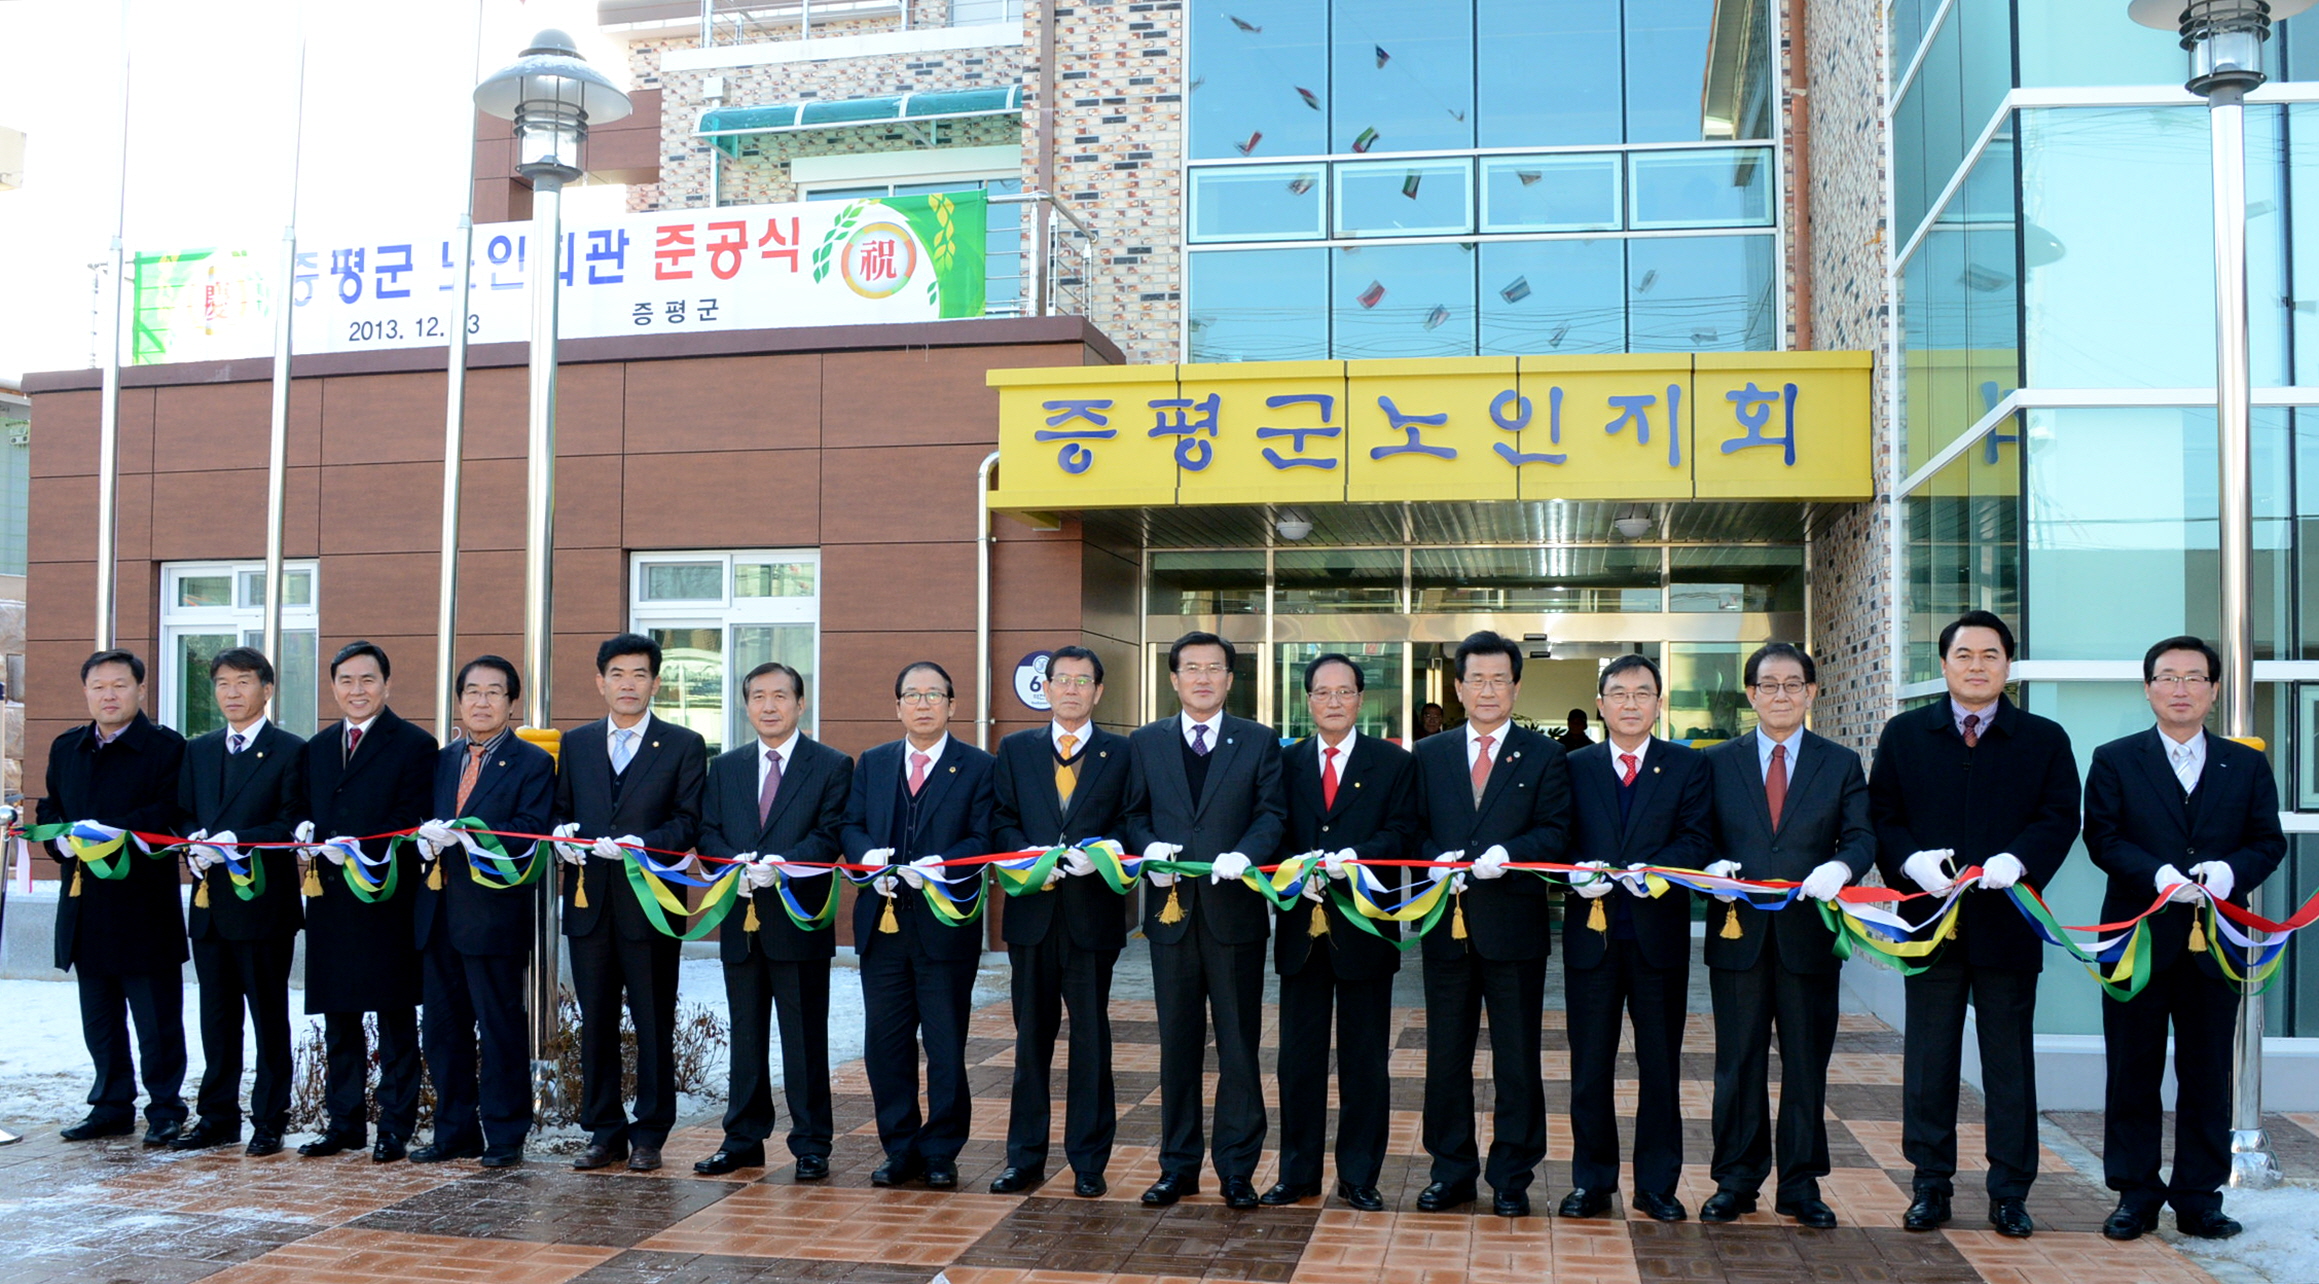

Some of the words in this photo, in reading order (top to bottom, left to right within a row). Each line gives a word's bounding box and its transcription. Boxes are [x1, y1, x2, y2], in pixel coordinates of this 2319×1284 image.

[294, 243, 414, 305] 증평군
[655, 216, 800, 281] 준공식
[860, 239, 898, 282] 祝
[349, 319, 404, 342] 2013.
[415, 316, 445, 338] 12.
